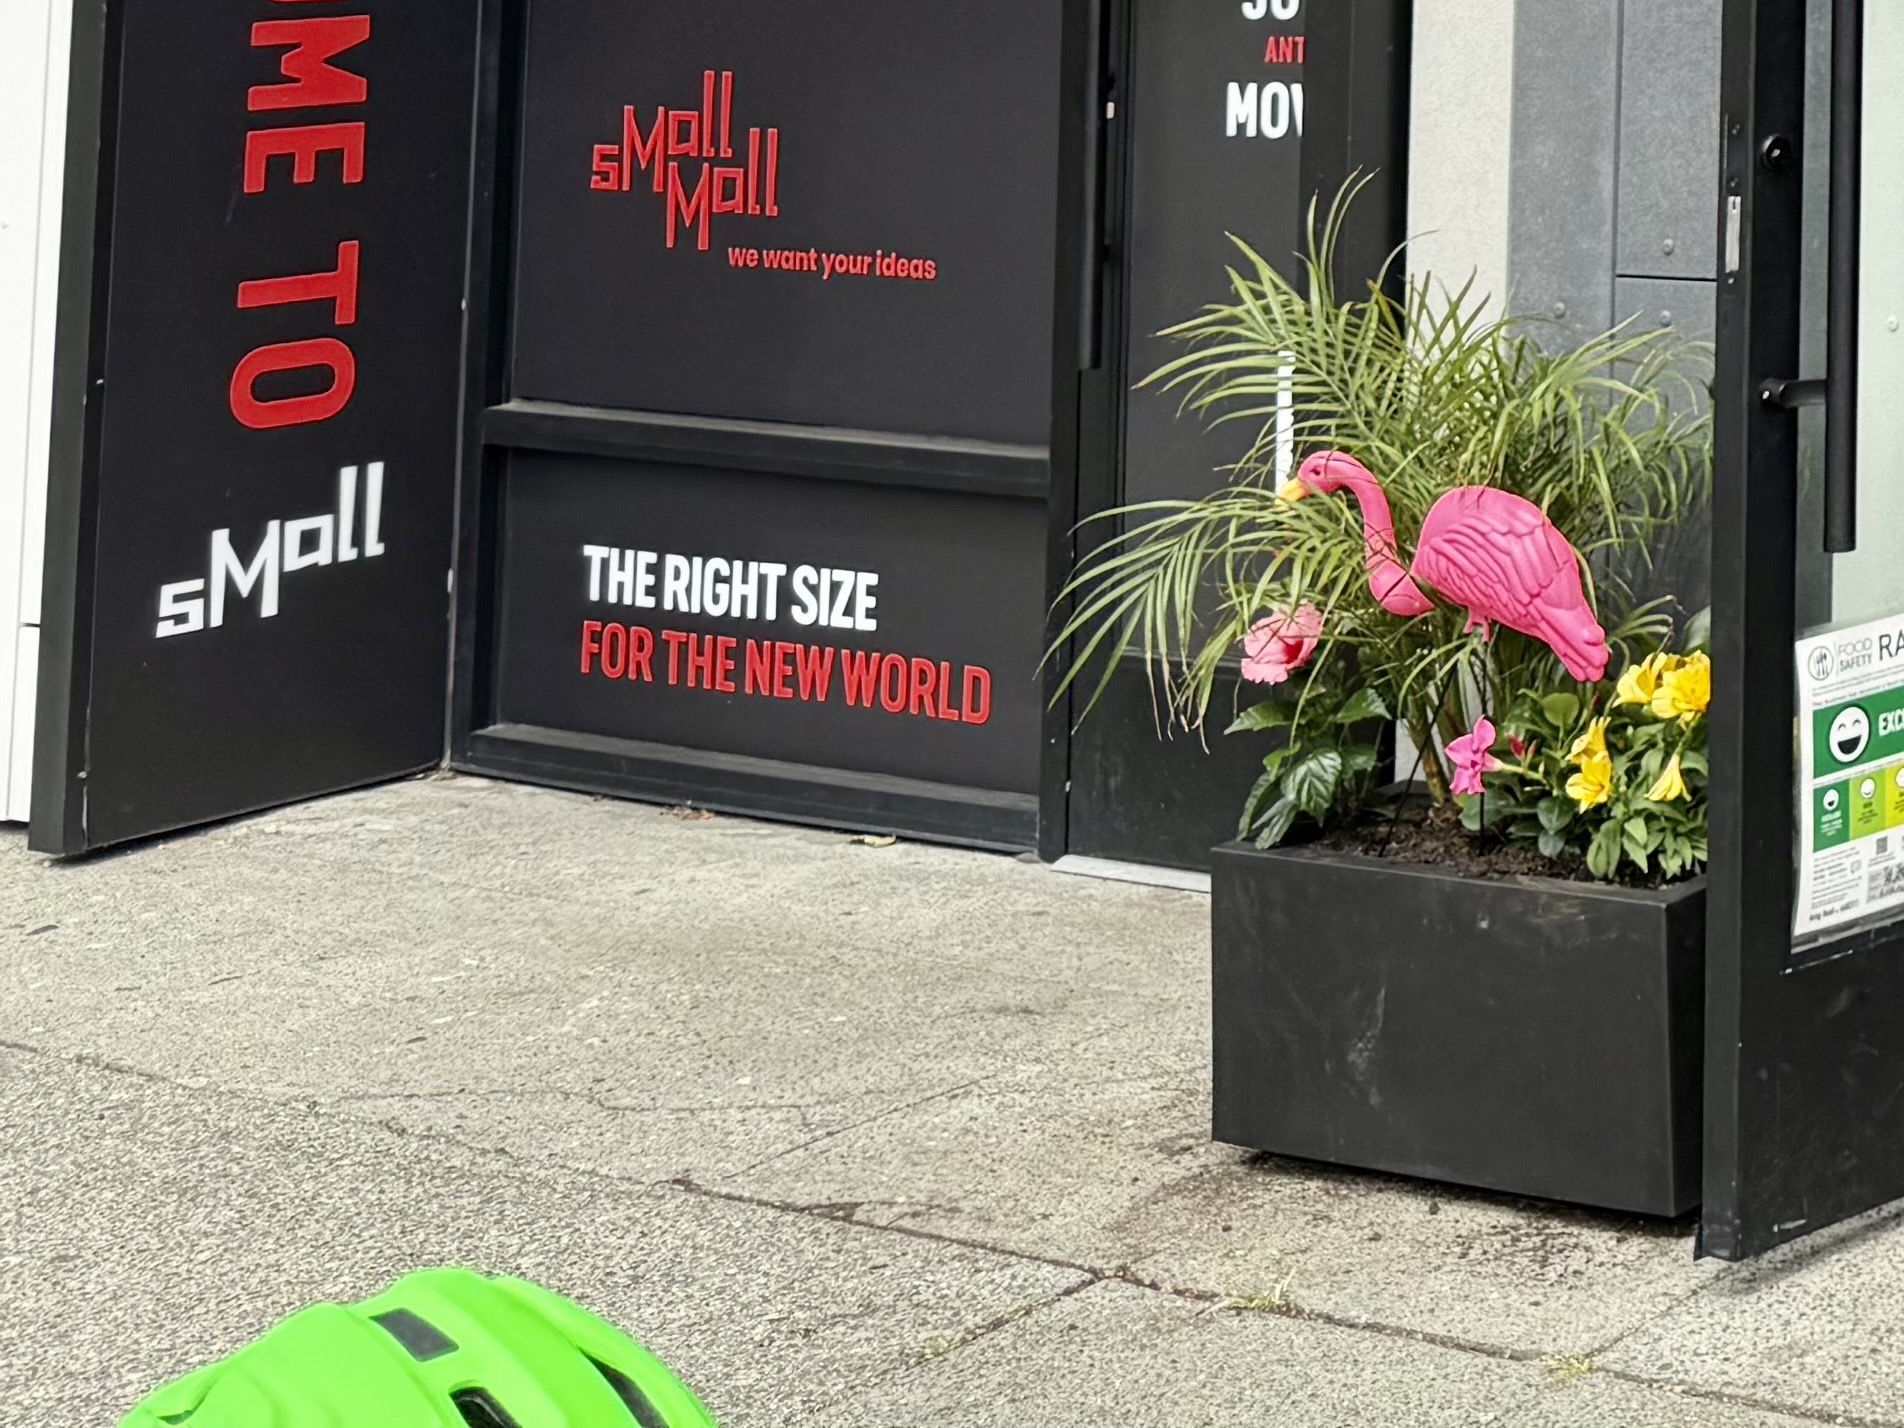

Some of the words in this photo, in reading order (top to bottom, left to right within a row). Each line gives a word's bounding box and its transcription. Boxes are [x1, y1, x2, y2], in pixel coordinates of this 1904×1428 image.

[727, 247, 759, 268] we
[762, 247, 818, 272] want
[821, 252, 873, 281] your
[875, 249, 938, 280] ideas
[229, 240, 361, 430] TO
[582, 543, 658, 610] THE
[663, 552, 788, 622] RIGHT
[790, 562, 880, 633] SIZE
[579, 619, 654, 684] FOR
[661, 629, 737, 694] THE
[744, 638, 835, 703] NEW
[840, 648, 992, 725] WORLD
[1837, 637, 1873, 658] FOOD
[1839, 652, 1873, 673] SAFETY
